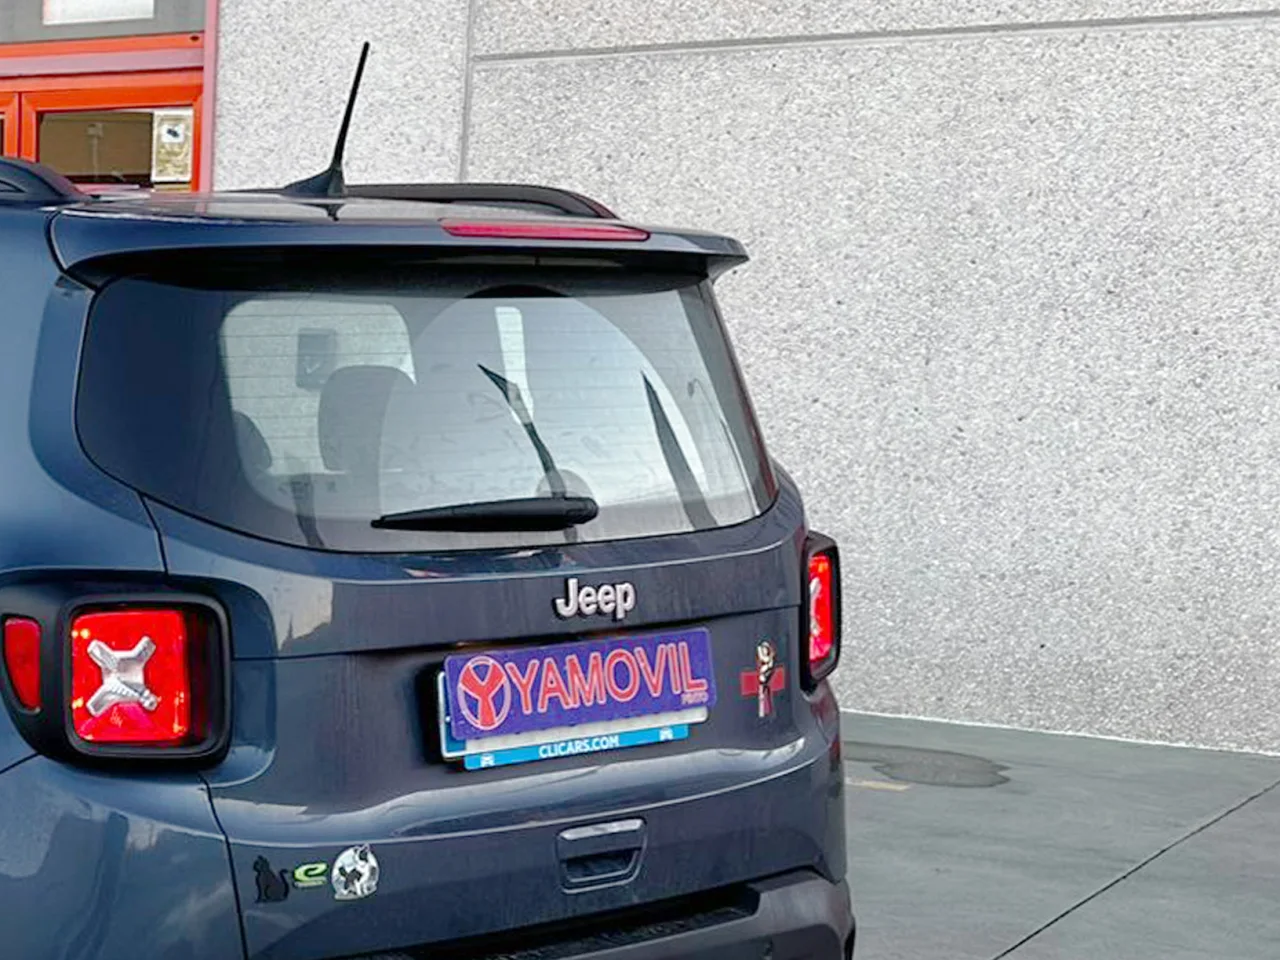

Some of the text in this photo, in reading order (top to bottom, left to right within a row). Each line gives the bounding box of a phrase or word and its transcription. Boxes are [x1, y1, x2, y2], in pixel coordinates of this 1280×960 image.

[555, 577, 637, 619] Jeep
[505, 642, 707, 714] YAMOVIL
[538, 735, 620, 759] CLICARS.COM
